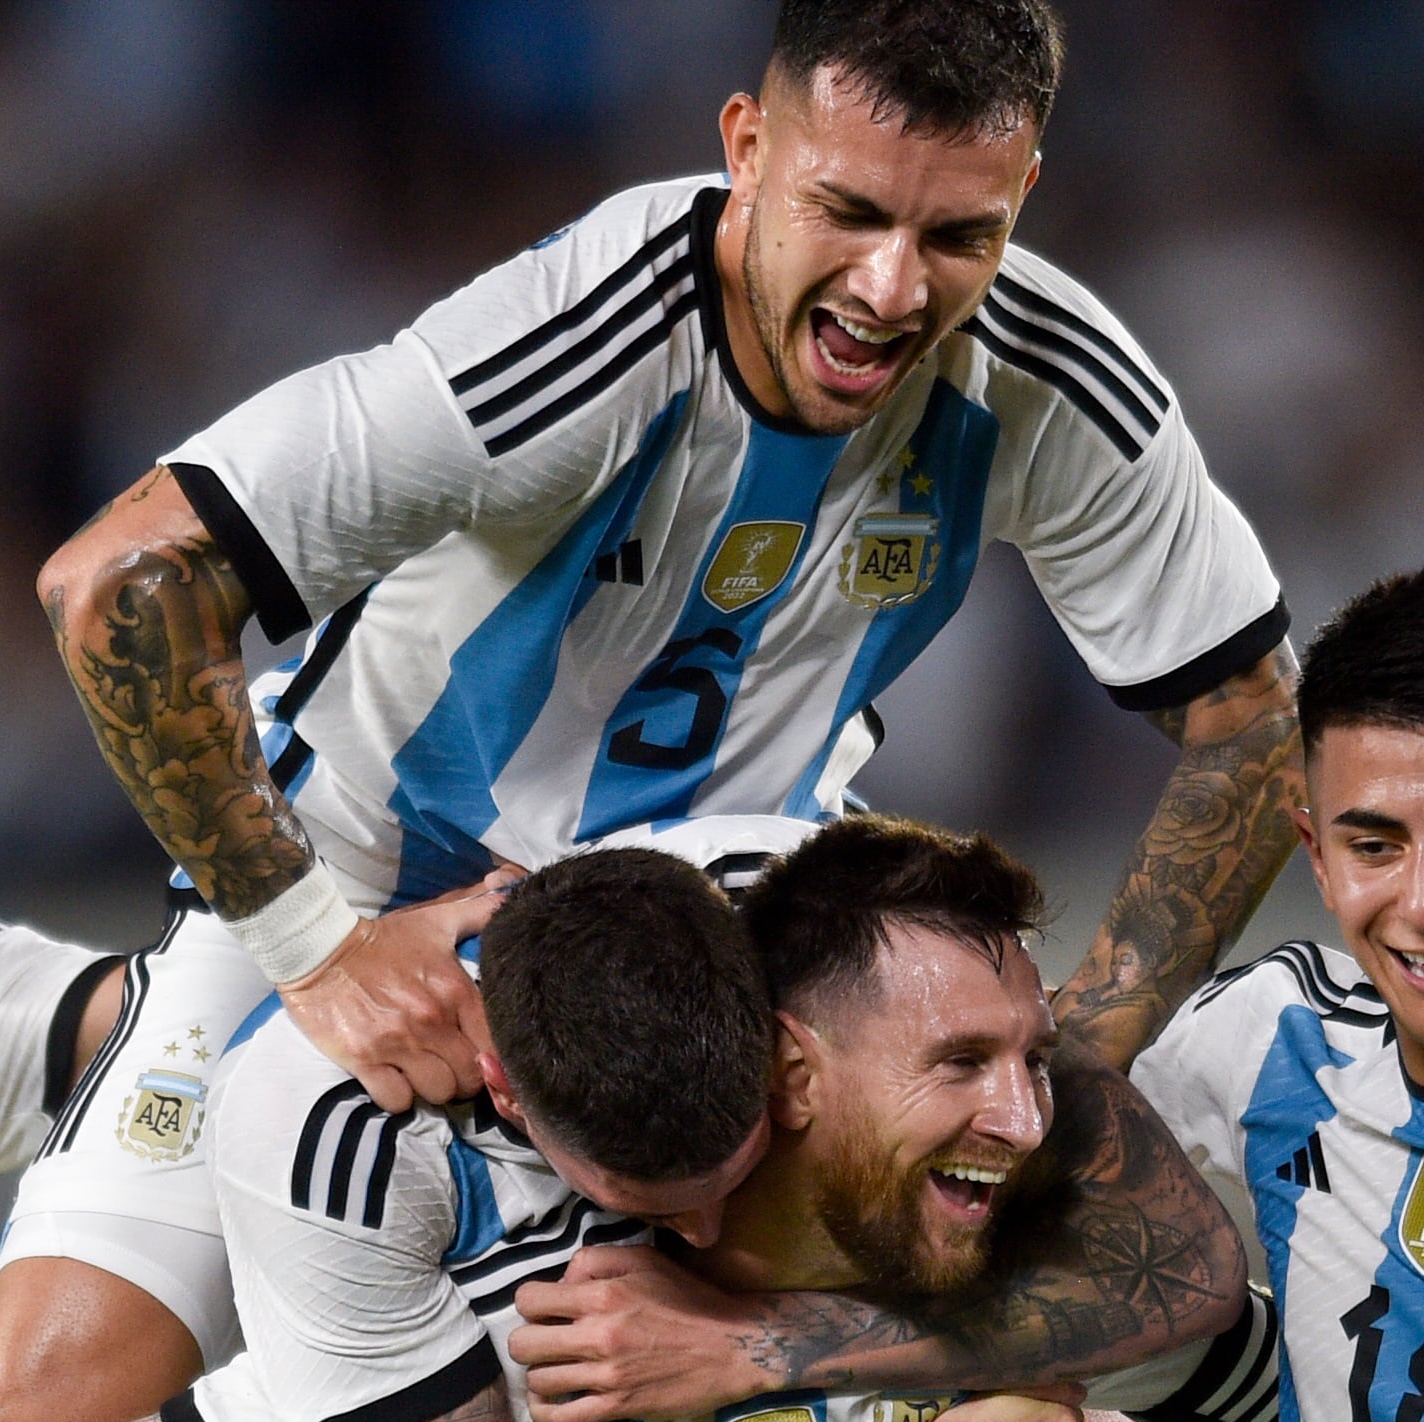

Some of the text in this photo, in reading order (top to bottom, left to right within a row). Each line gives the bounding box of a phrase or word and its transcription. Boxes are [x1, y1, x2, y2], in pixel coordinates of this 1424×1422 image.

[860, 538, 913, 582] AFA
[722, 577, 758, 588] FIFA
[607, 627, 743, 770] 5
[135, 1092, 183, 1136] AFA
